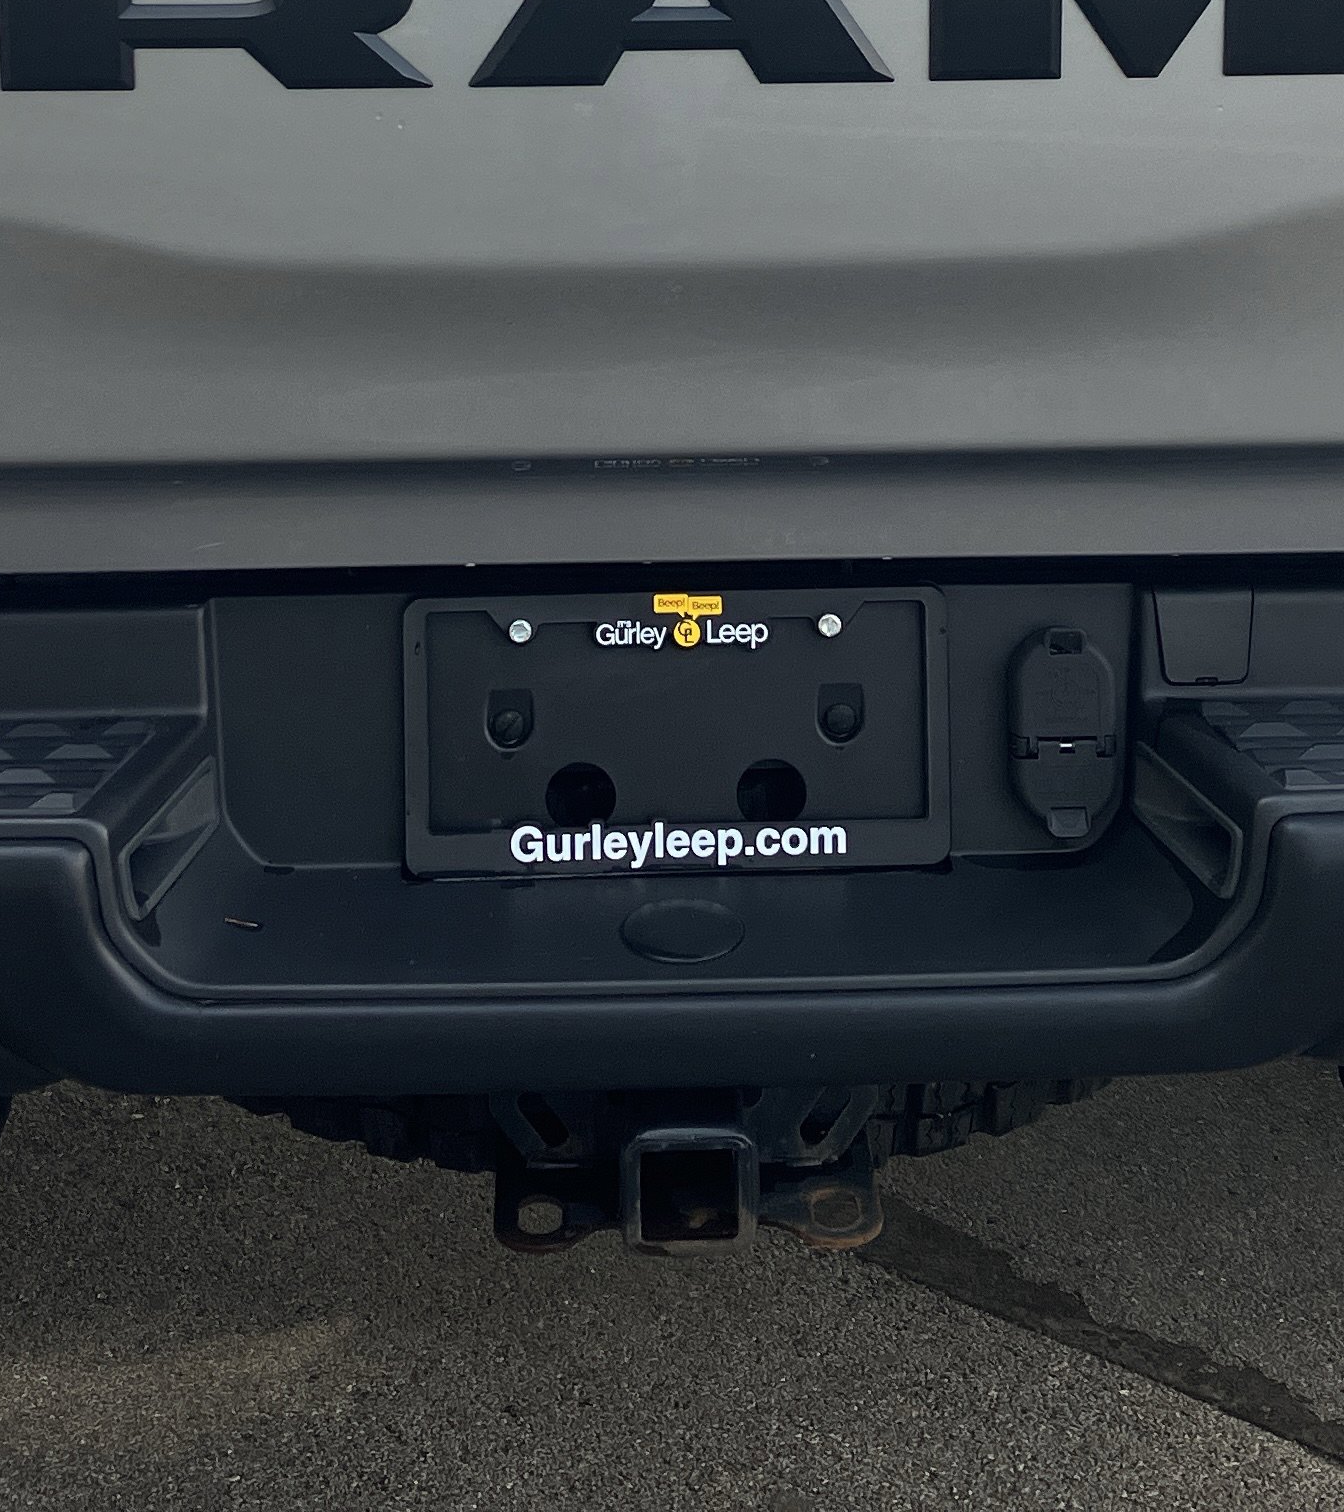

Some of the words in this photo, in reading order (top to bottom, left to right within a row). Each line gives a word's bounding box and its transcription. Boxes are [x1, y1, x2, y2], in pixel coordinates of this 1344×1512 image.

[658, 598, 685, 609] Beep!
[692, 601, 720, 611] Beep!
[595, 621, 667, 650] Gurley
[706, 619, 769, 650] Leep
[509, 821, 847, 869] Gurleyleep.com
